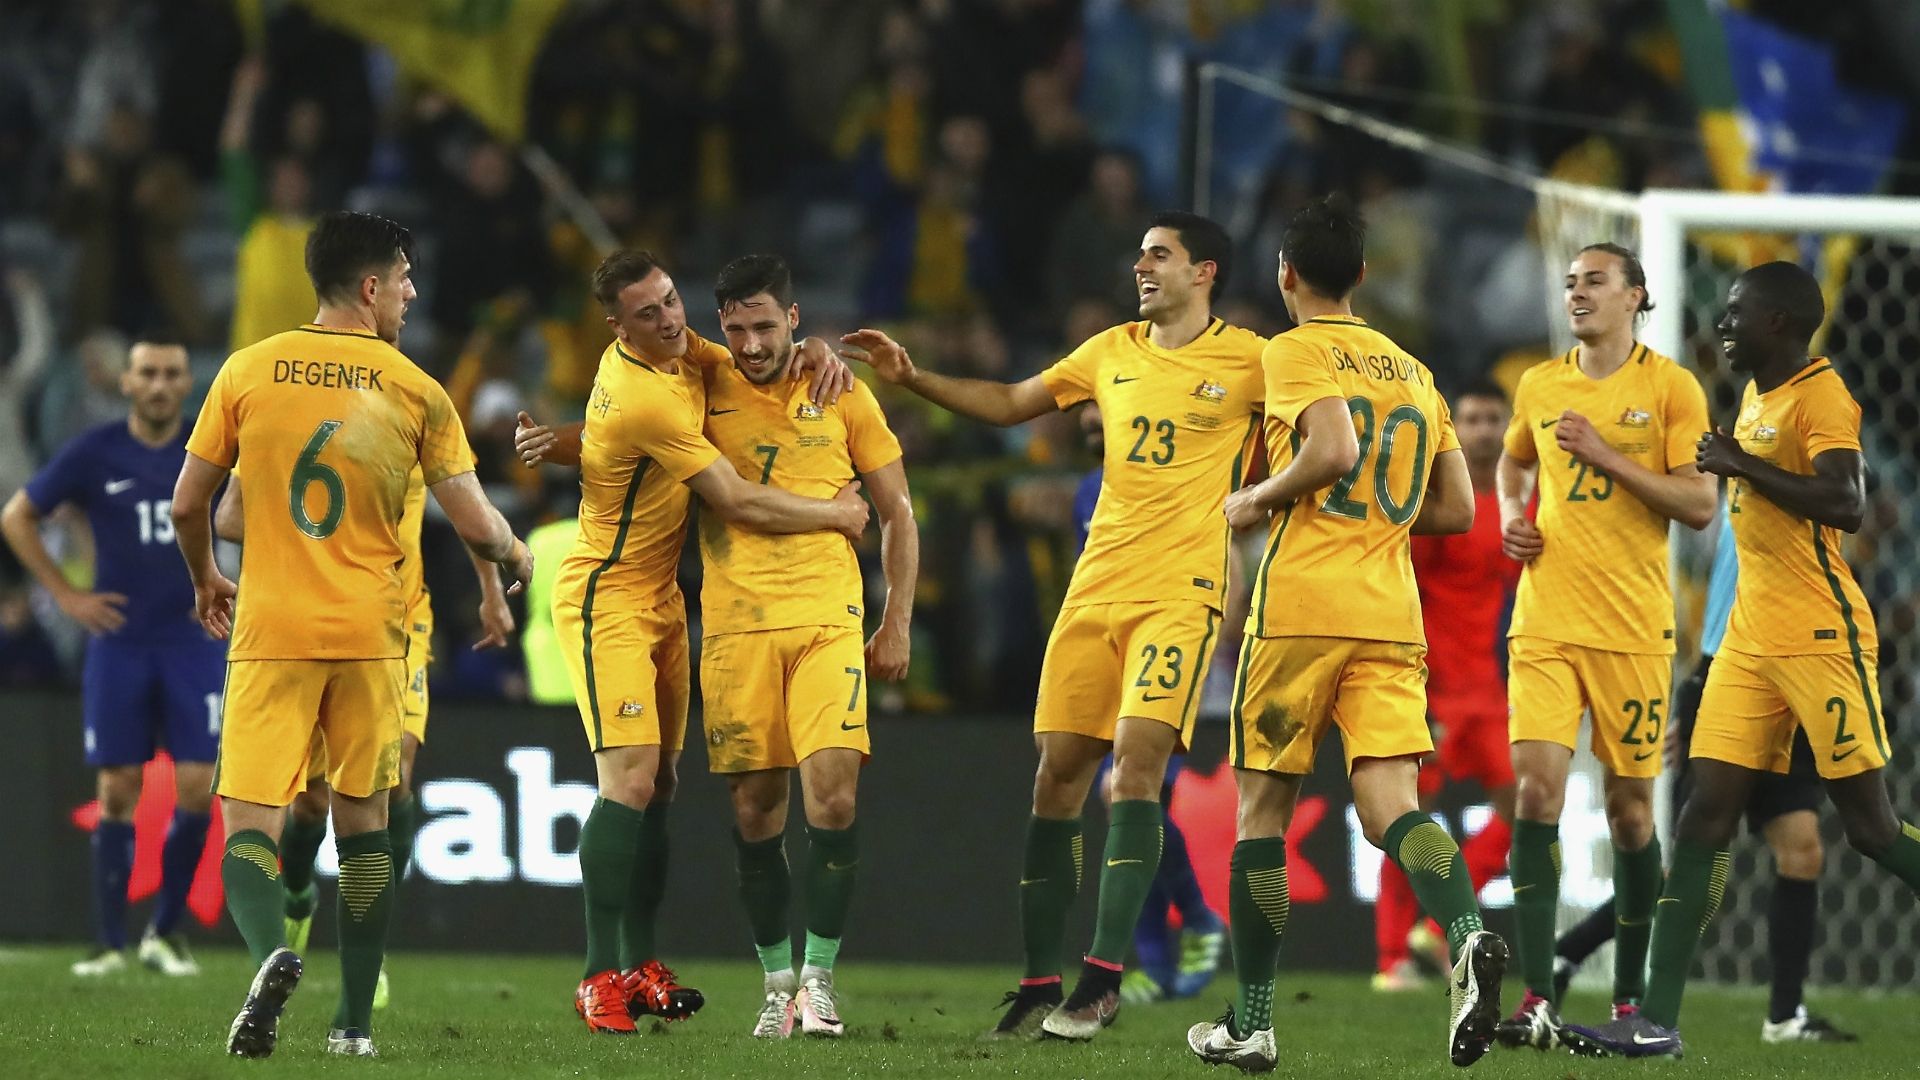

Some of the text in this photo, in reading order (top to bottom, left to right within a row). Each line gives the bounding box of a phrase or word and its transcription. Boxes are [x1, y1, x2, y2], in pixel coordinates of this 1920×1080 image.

[274, 360, 384, 392] DEGENEK
[1126, 415, 1176, 466] 23
[1319, 395, 1428, 525] 20
[288, 419, 346, 540] 6
[756, 445, 779, 485] 7
[1566, 453, 1613, 501] 25
[134, 499, 176, 545] 15
[844, 666, 862, 712] 7
[1135, 644, 1183, 690] 23
[203, 692, 223, 737] 1
[1620, 698, 1662, 745] 25
[1826, 696, 1856, 746] 2
[314, 746, 598, 887] ab
